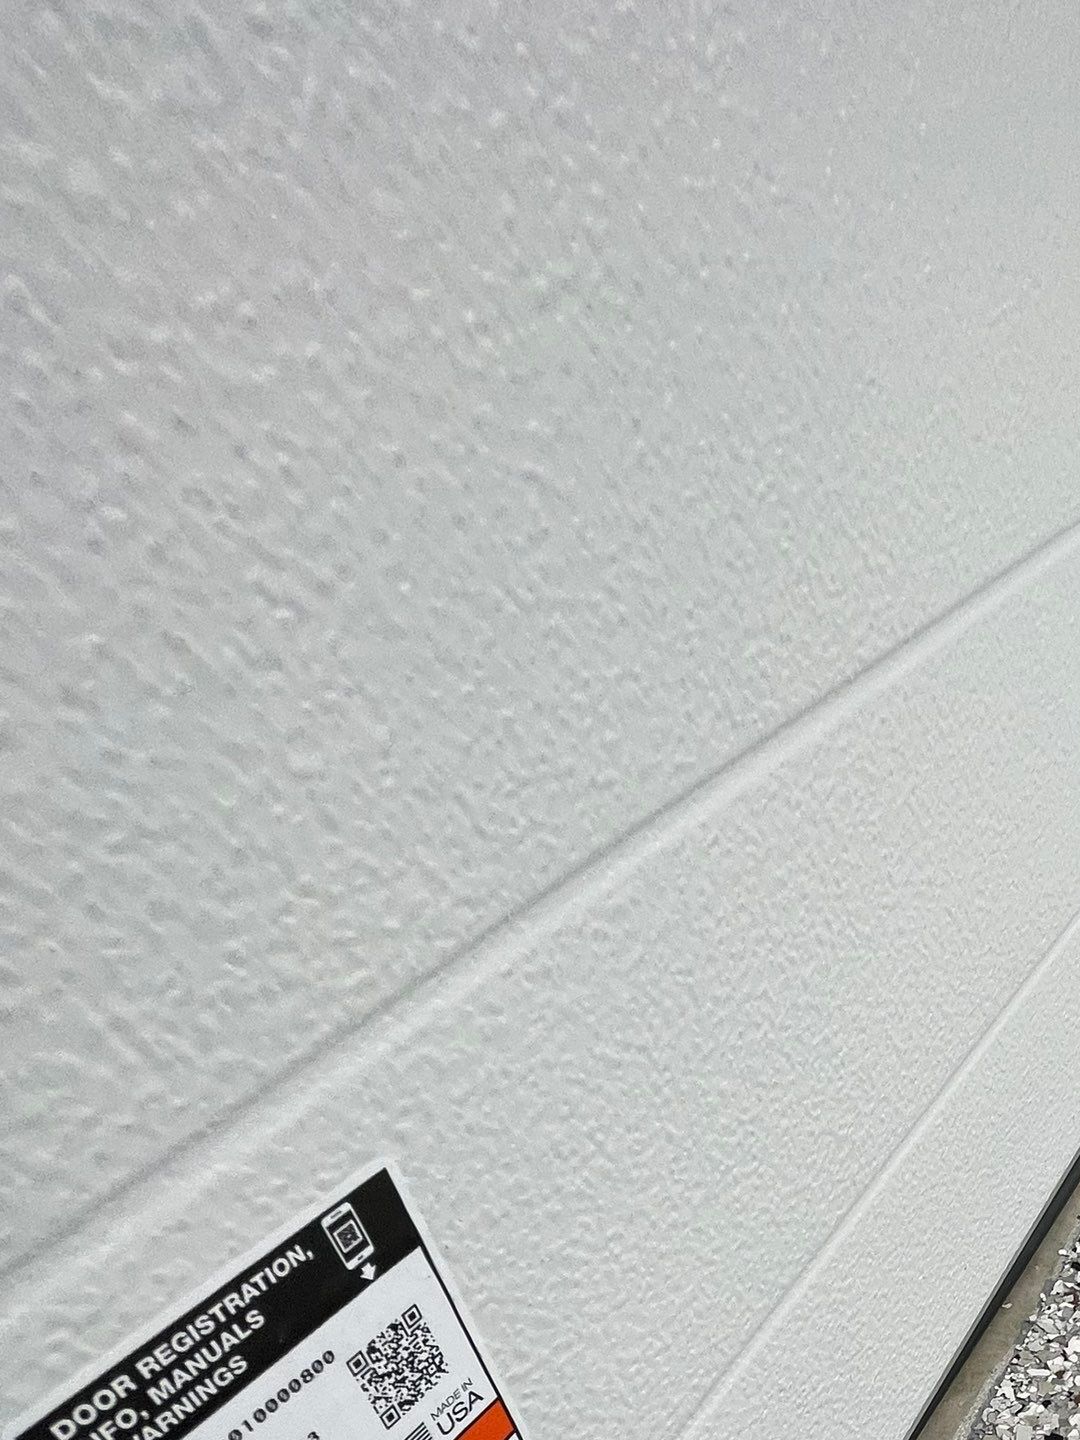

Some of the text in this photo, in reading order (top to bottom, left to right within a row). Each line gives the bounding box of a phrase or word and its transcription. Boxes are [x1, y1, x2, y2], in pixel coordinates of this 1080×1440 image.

[135, 1244, 314, 1380] REGISTRATION,
[146, 1309, 265, 1406] MANUALS
[429, 1377, 474, 1422] MADE IN
[436, 1390, 485, 1436] USA
